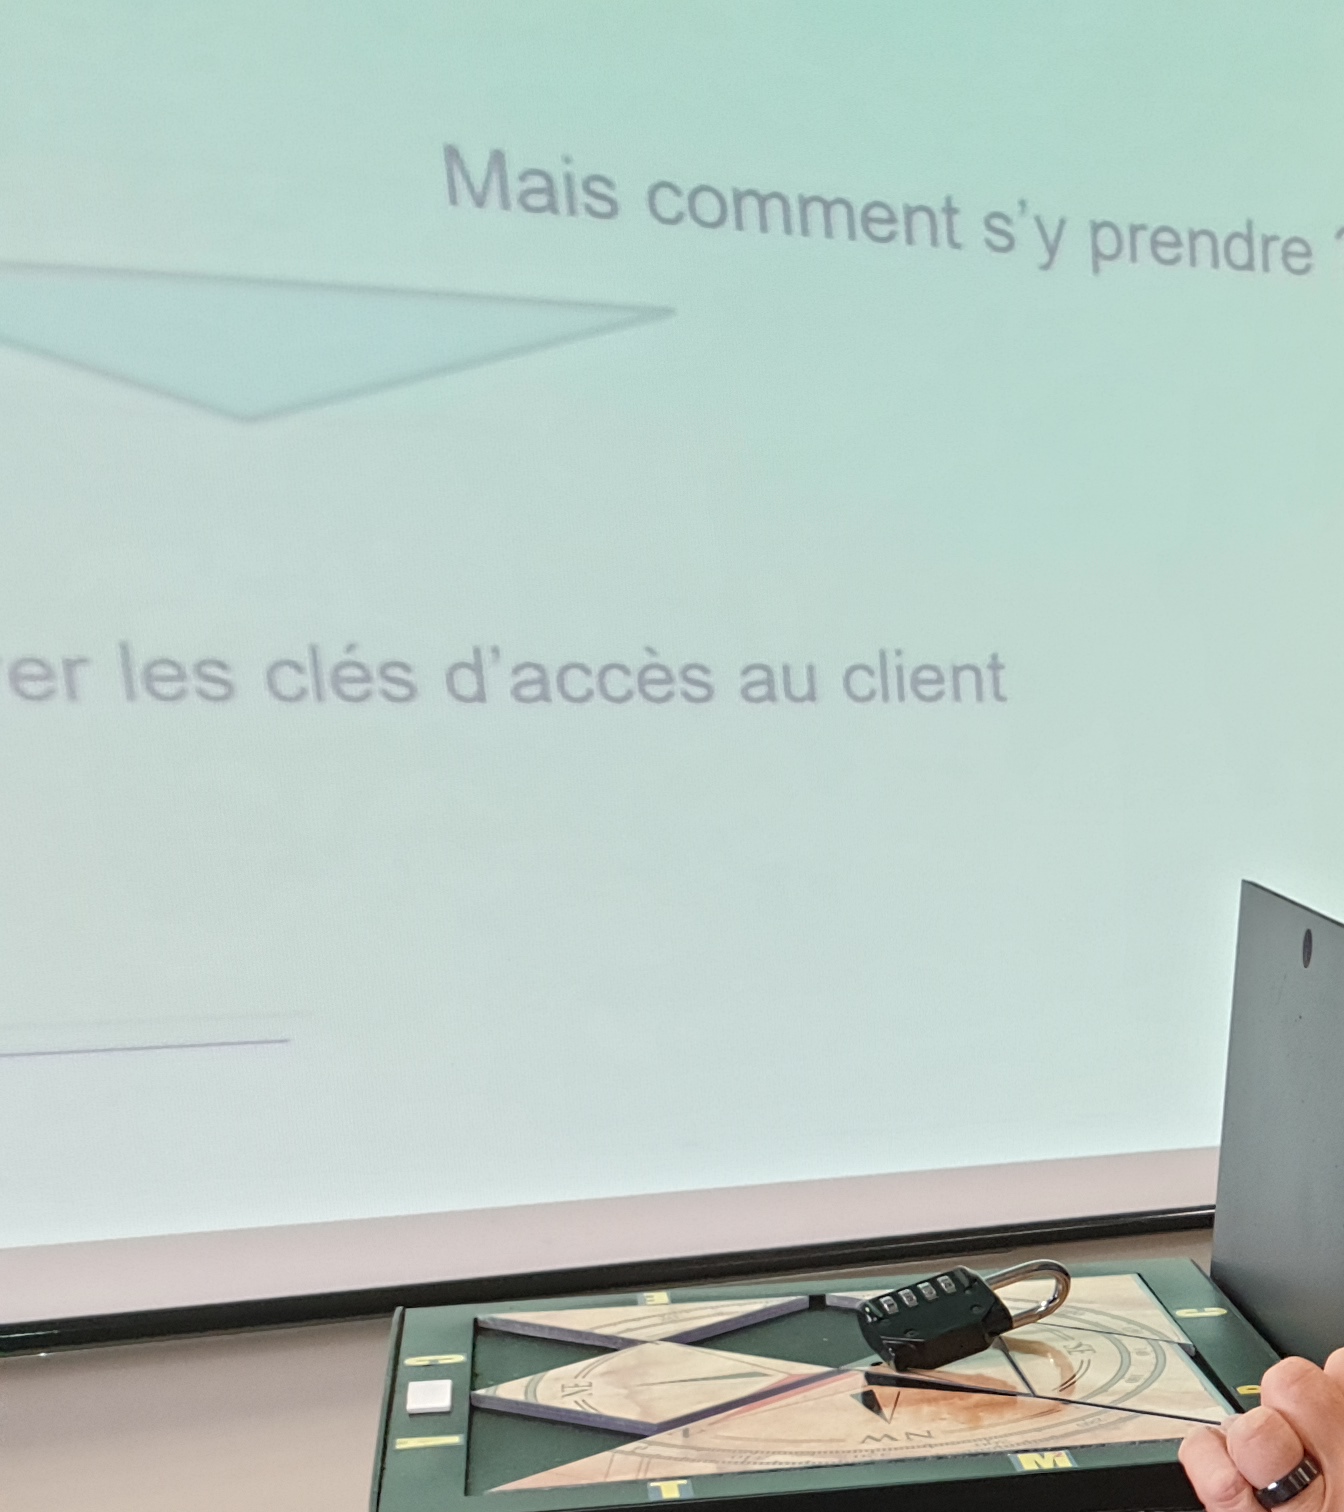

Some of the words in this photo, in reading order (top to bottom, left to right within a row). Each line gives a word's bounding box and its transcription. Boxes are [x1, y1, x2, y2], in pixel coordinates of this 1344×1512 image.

[441, 142, 621, 222] Mais
[645, 178, 965, 252] comment
[1088, 217, 1315, 277] prendre
[0, 655, 91, 704] er
[118, 640, 236, 704] les
[265, 641, 419, 704] clés
[739, 661, 819, 705] au
[842, 648, 1009, 705] client
[1016, 1452, 1074, 1471] M
[650, 1479, 688, 1500] T
